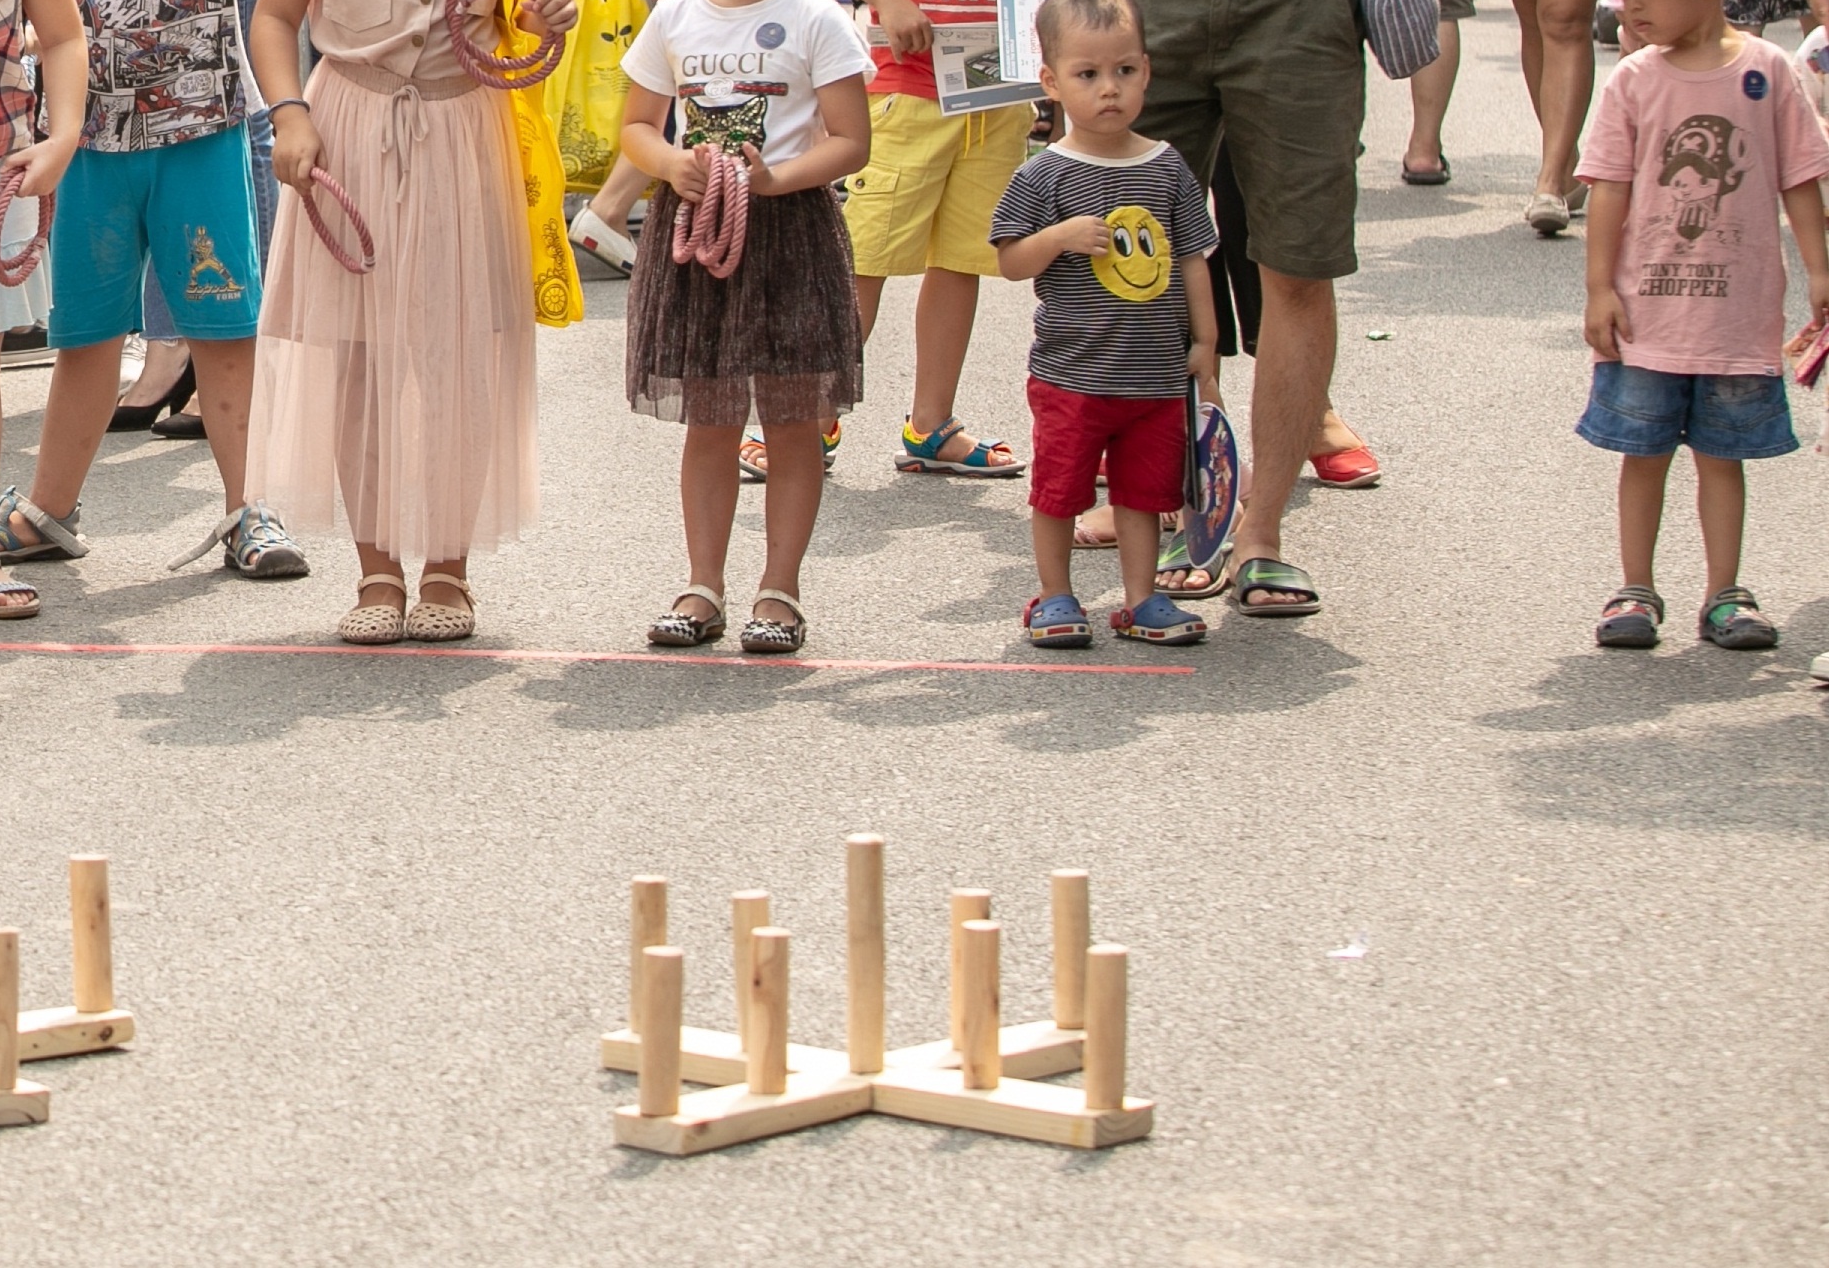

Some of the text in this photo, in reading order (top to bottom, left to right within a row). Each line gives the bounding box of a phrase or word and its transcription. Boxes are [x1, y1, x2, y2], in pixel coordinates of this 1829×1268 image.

[682, 52, 765, 78] GUCCI
[1642, 263, 1682, 277] TONY
[1638, 278, 1729, 298] CHOPPER
